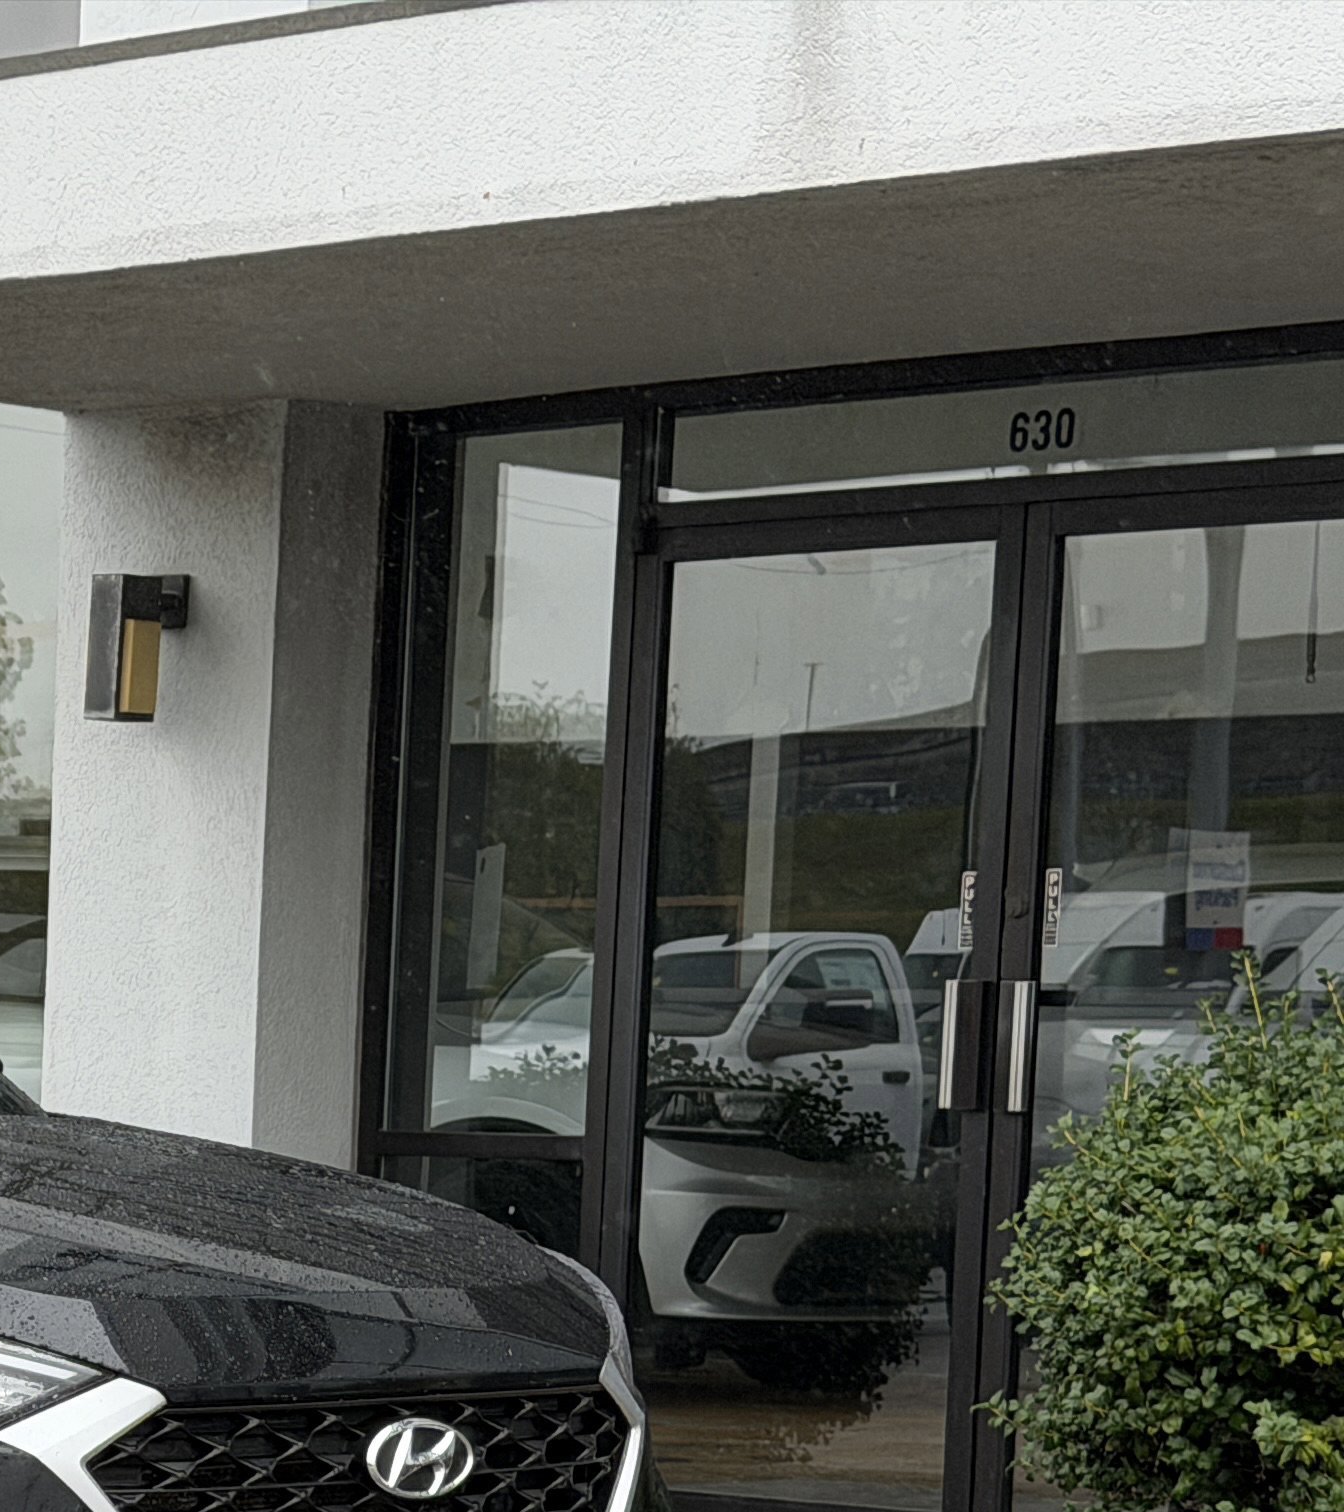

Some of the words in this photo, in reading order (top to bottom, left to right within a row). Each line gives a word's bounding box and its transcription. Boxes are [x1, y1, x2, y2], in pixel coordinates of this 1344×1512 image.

[1009, 407, 1076, 452] 630
[963, 875, 976, 925] PULL
[1047, 872, 1059, 922] PULL
